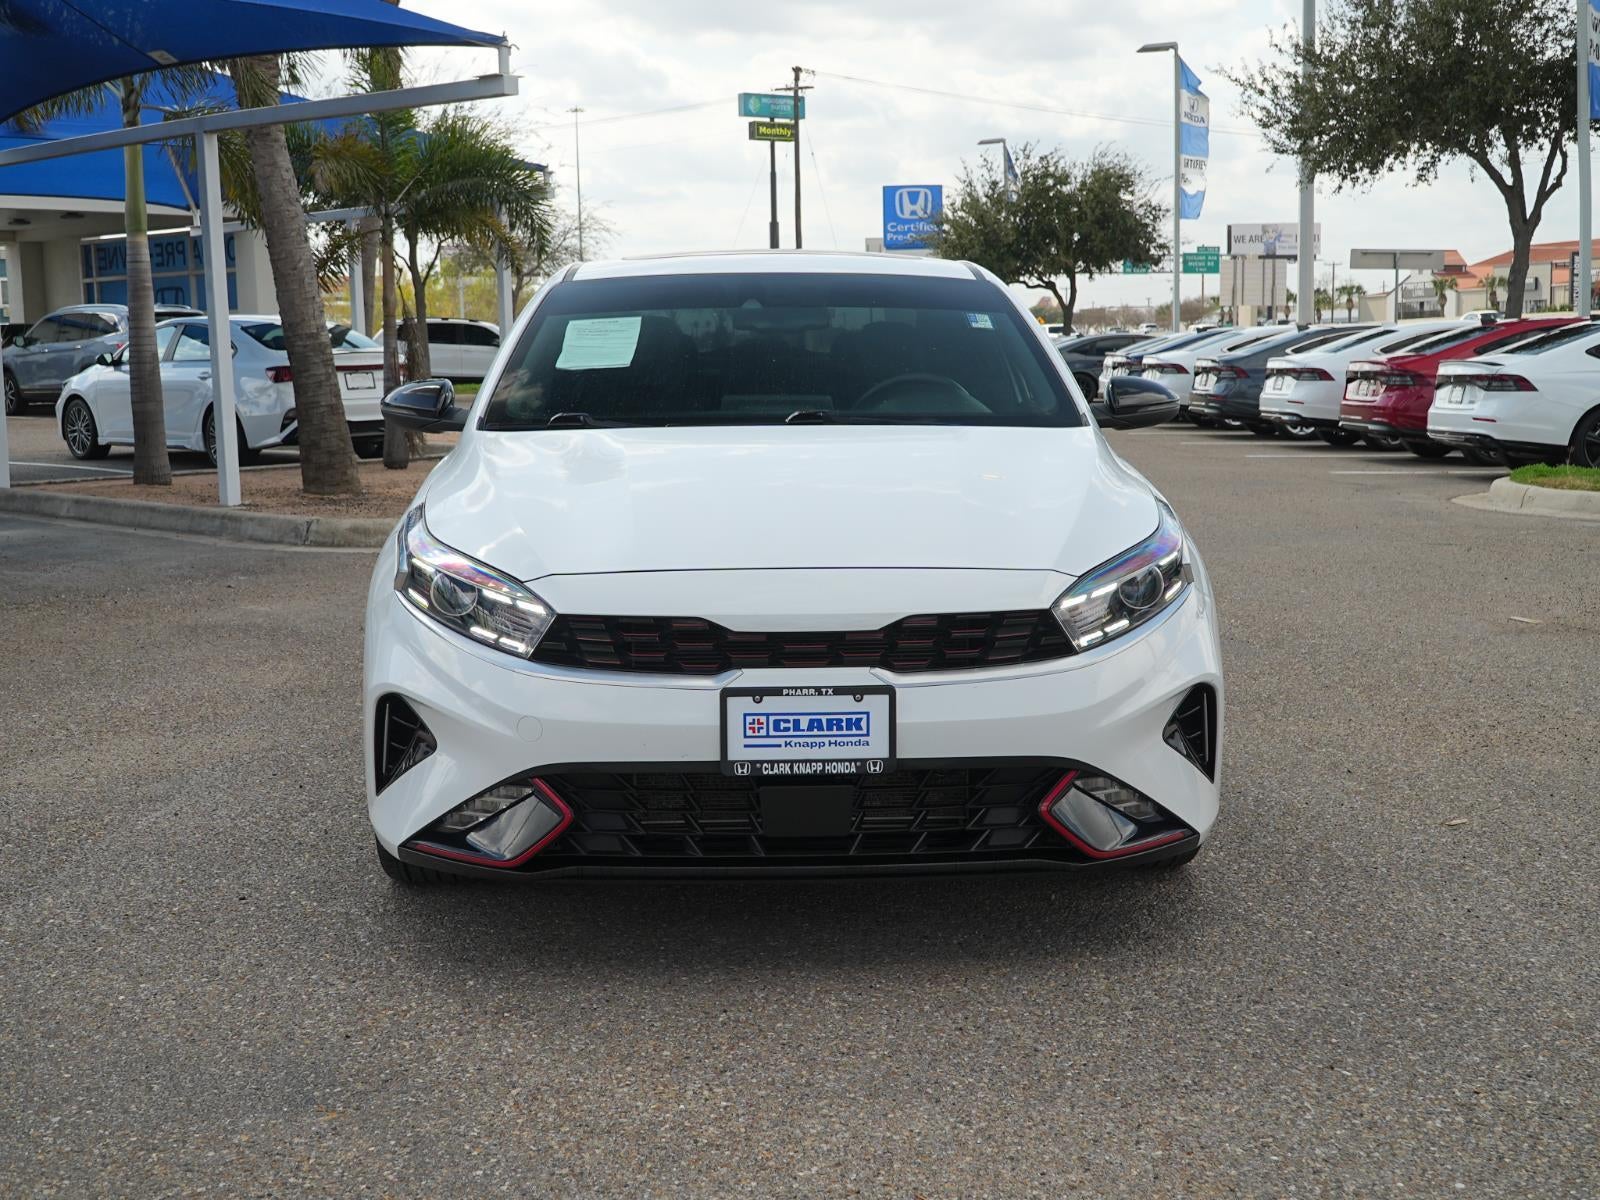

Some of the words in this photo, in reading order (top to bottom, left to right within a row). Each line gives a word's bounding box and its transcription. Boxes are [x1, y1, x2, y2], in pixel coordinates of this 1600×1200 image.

[759, 126, 792, 137] Monthly
[1233, 234, 1246, 244] WE
[782, 688, 819, 696] PHARR,
[820, 688, 834, 696] TX
[772, 717, 864, 733] CLARK
[784, 740, 826, 750] Knapp
[828, 738, 871, 748] Honda
[762, 762, 792, 775] CLARK
[793, 762, 823, 775] KNAPP
[824, 761, 857, 774] HONDA
